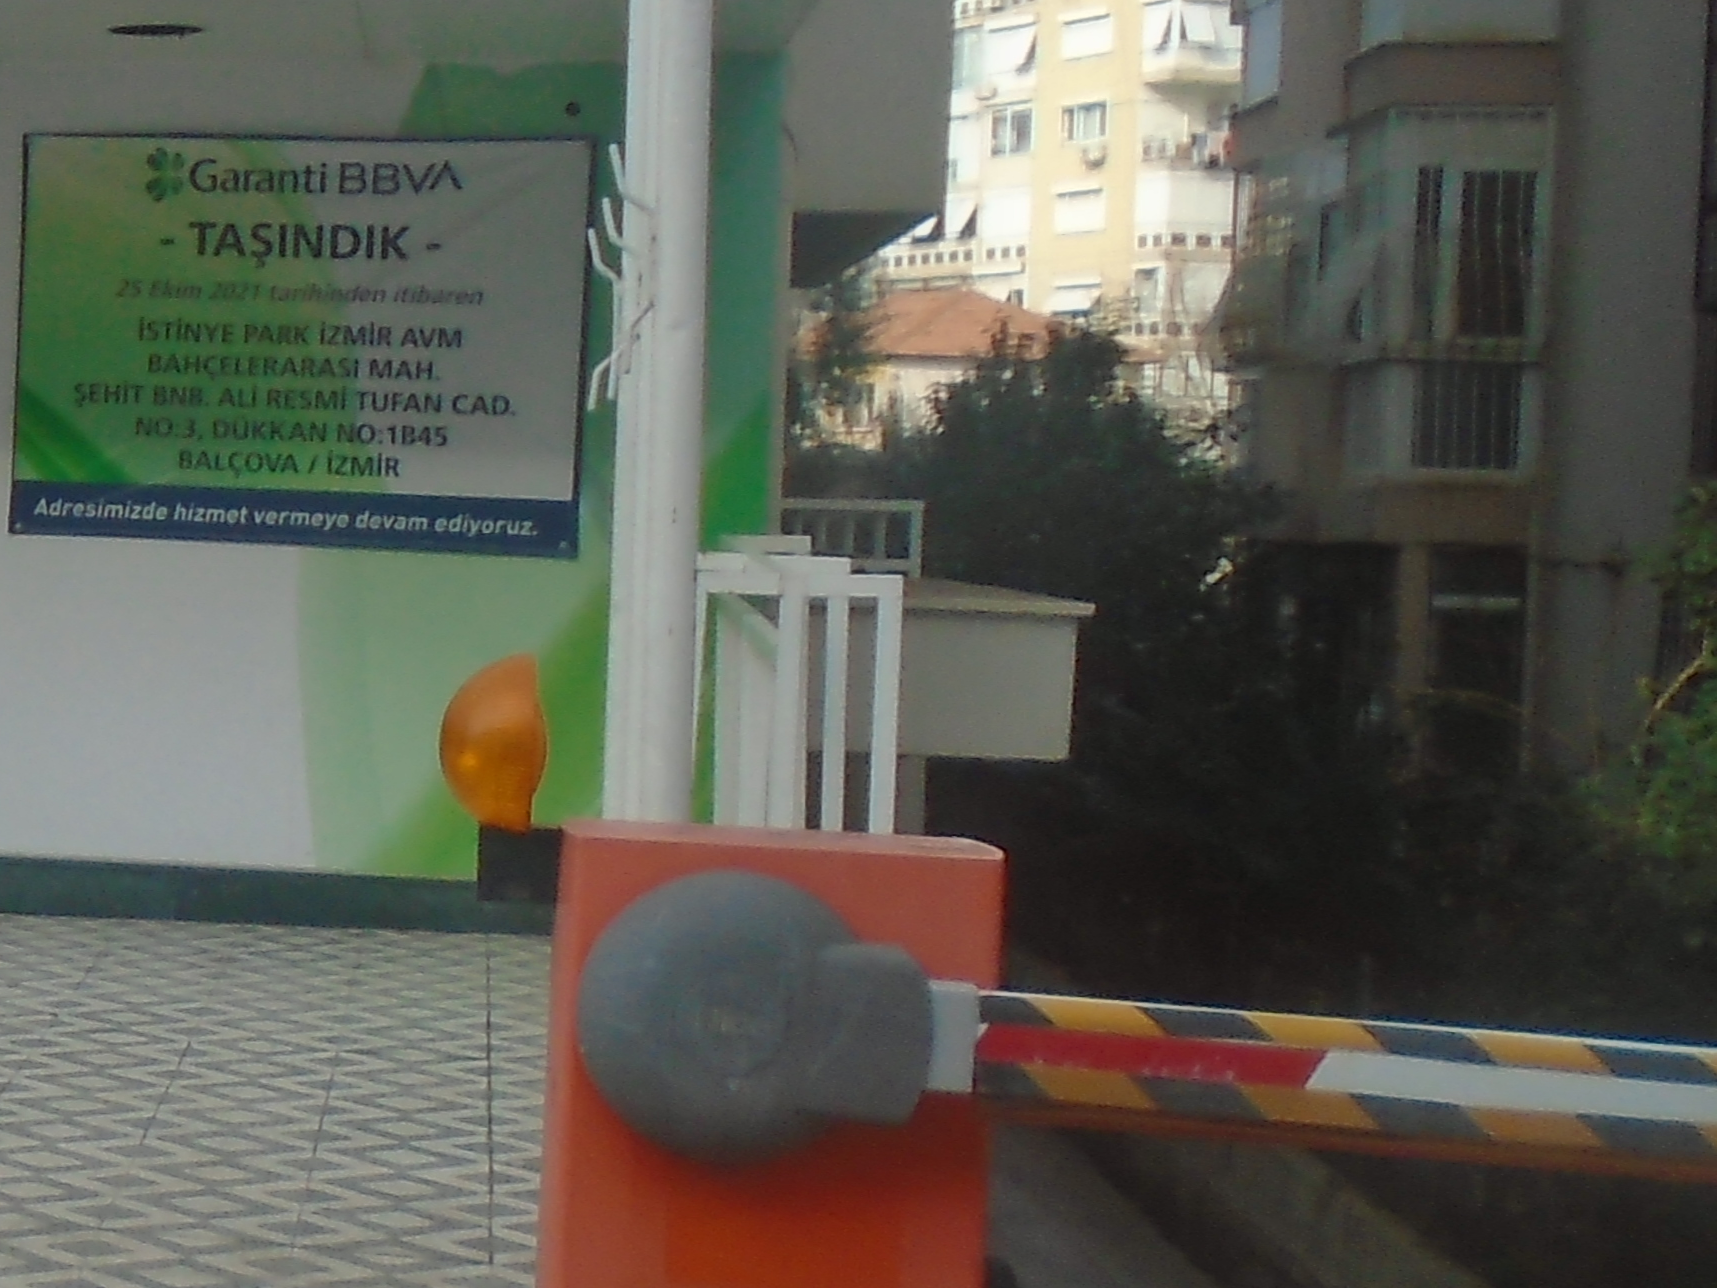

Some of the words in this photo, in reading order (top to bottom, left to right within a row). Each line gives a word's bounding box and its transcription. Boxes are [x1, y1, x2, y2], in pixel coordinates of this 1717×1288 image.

[189, 159, 328, 195] Garanti
[339, 159, 463, 194] BBVA
[188, 220, 411, 268] TAŞINDIK
[138, 316, 234, 343] İSTİNYE
[243, 323, 310, 346] PARK
[319, 321, 393, 348] İZMİR
[401, 326, 463, 349] AVM
[73, 380, 144, 408] ŞEHİT
[217, 383, 258, 408] ALİ
[266, 384, 347, 412] RESMİ
[357, 390, 442, 414] TUFAN
[452, 394, 516, 418] CAD.
[212, 415, 328, 444] DÜKKAN
[177, 449, 300, 479] BALÇOVA
[325, 448, 401, 478] İZMİR
[34, 496, 169, 521] Adresimizde
[173, 501, 248, 525] hizmet
[253, 510, 350, 533] vermeye
[355, 510, 429, 533] devam
[433, 512, 539, 539] ediyoruz.
